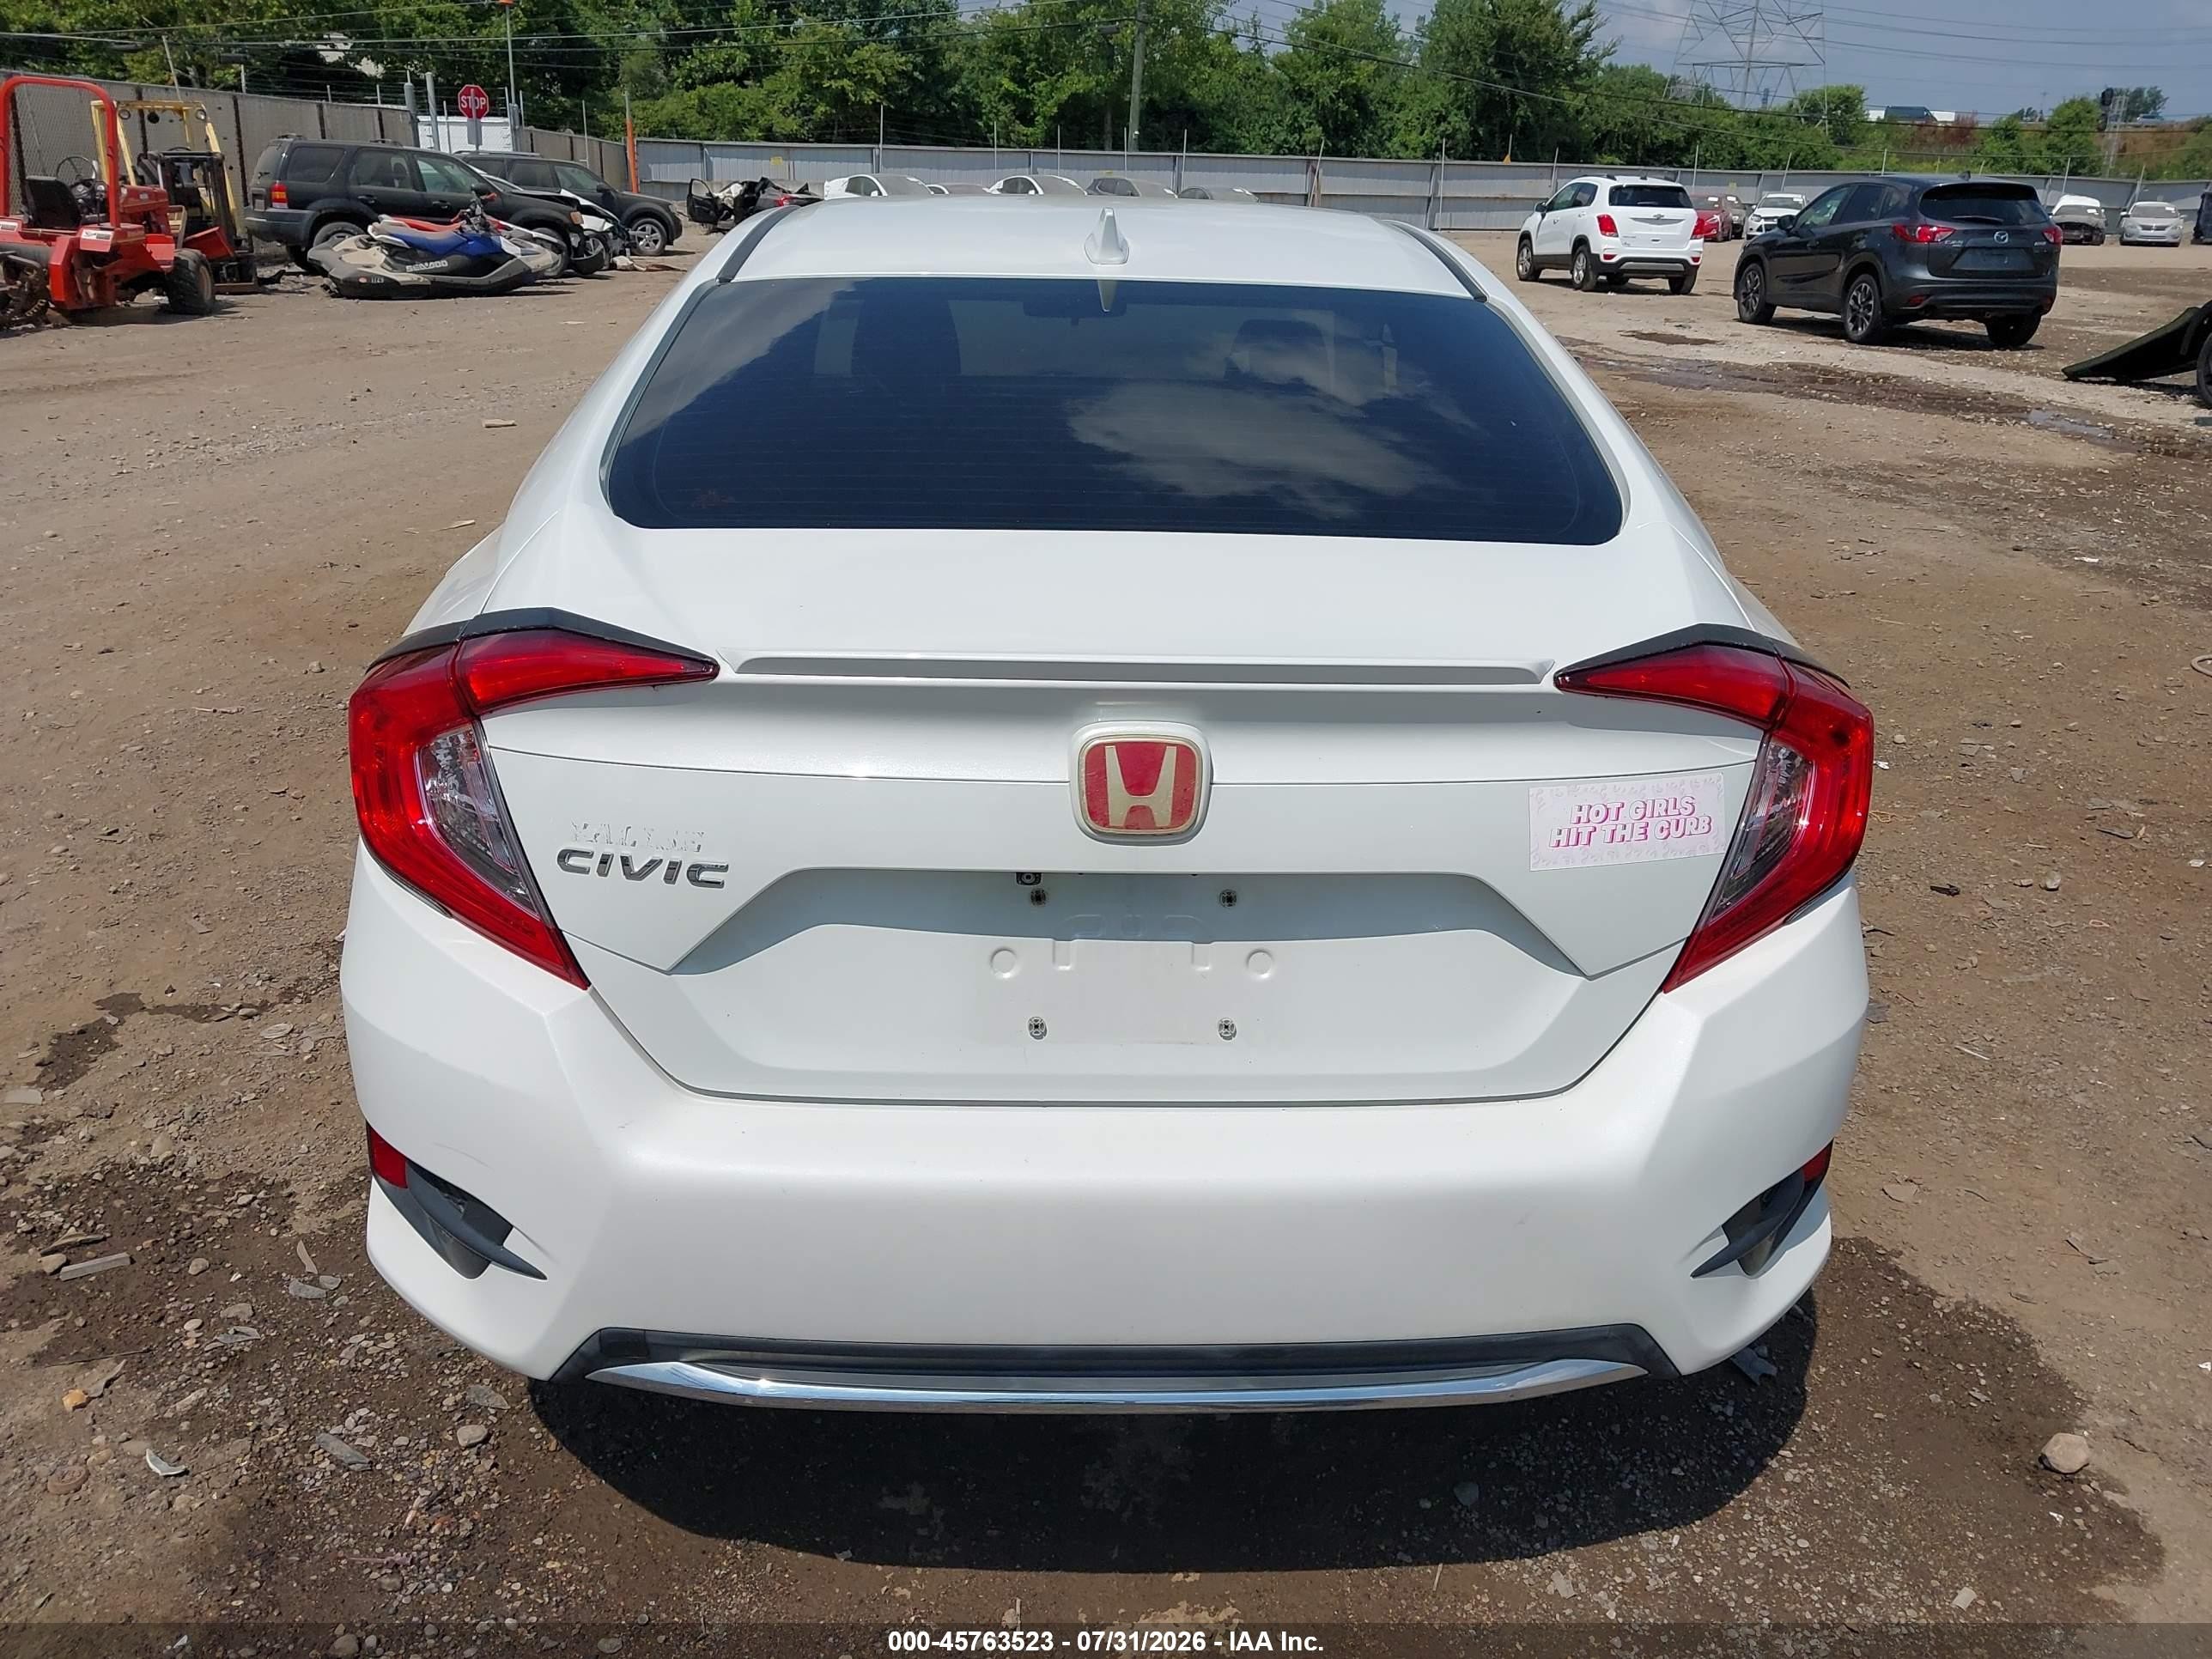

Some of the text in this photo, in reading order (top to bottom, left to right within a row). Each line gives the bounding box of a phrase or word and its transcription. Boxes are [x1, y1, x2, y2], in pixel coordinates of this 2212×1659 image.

[1571, 796, 1697, 824] HOT GIRLS
[1549, 816, 1712, 848] HIT THE CURB
[556, 848, 729, 889] CIVIC
